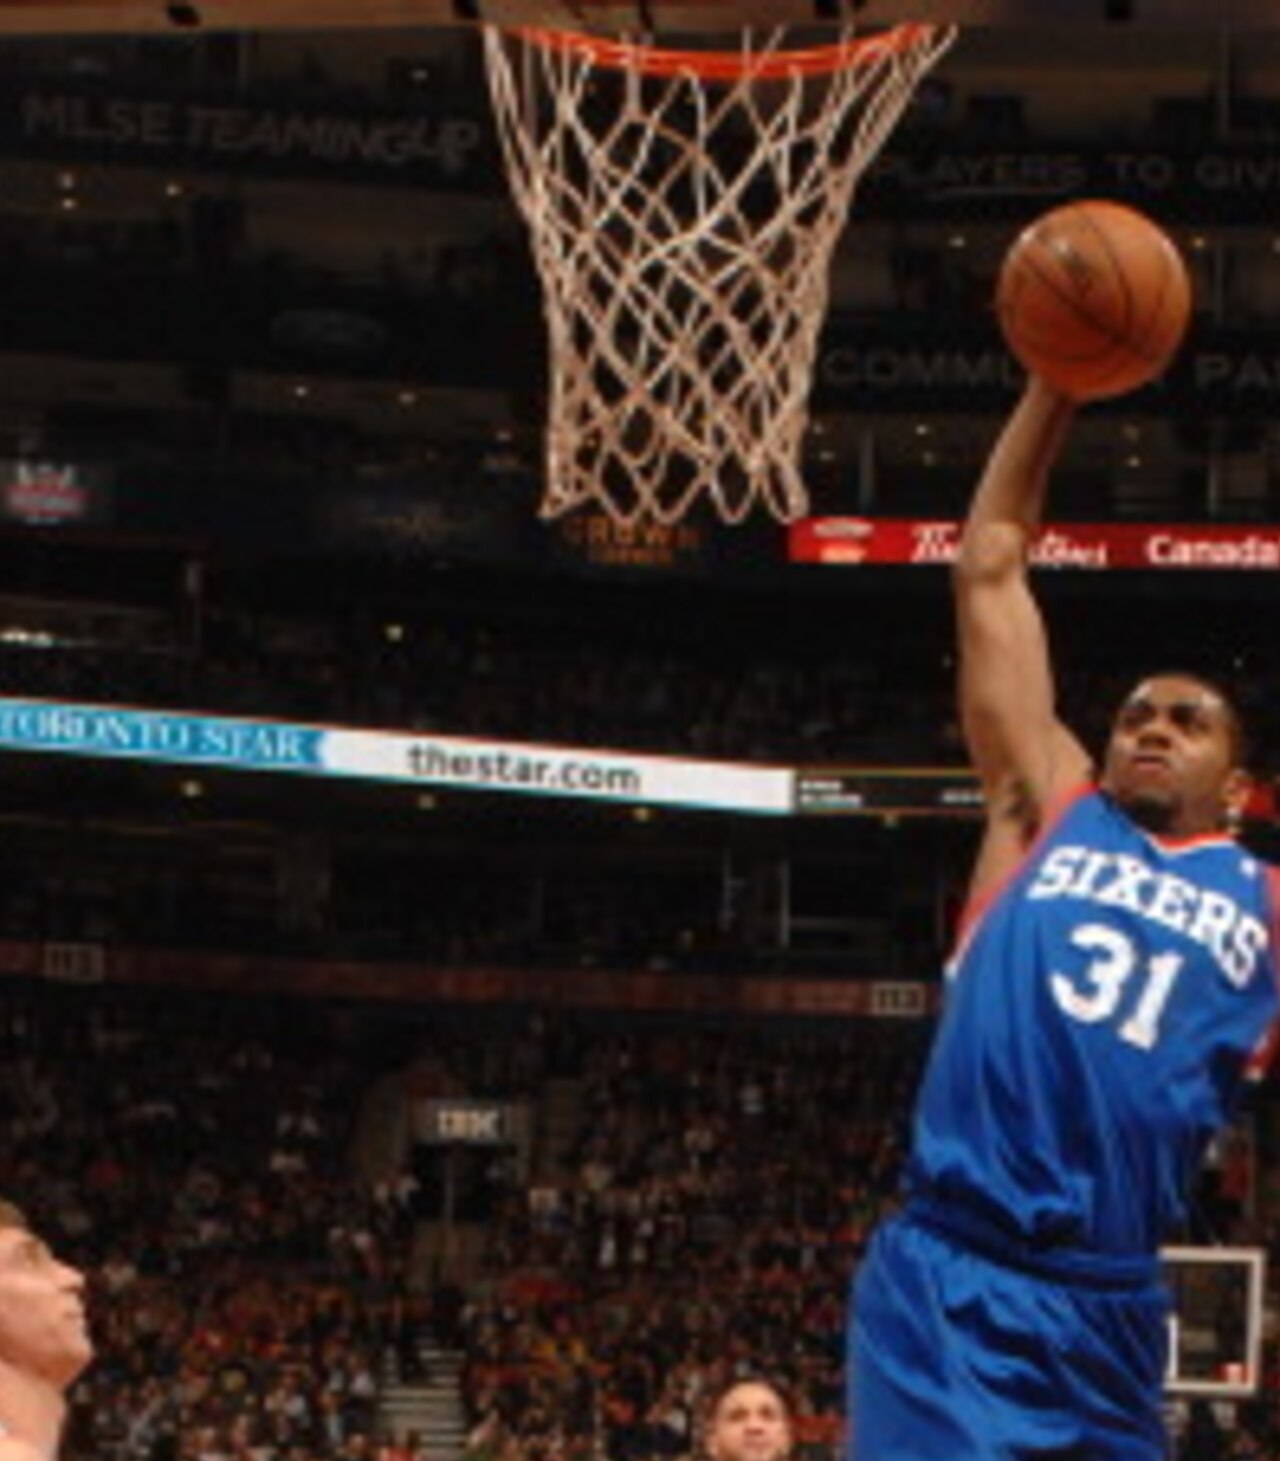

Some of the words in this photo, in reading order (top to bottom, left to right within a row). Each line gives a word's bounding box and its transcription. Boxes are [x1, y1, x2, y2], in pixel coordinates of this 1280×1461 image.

[22, 95, 171, 144] MLSE
[1113, 153, 1173, 188] TO
[0, 706, 191, 750] TORONTO
[201, 728, 305, 762] STAR
[407, 743, 640, 792] thestar.com
[1027, 845, 1269, 990] SIXERS
[1051, 924, 1184, 1051] 31
